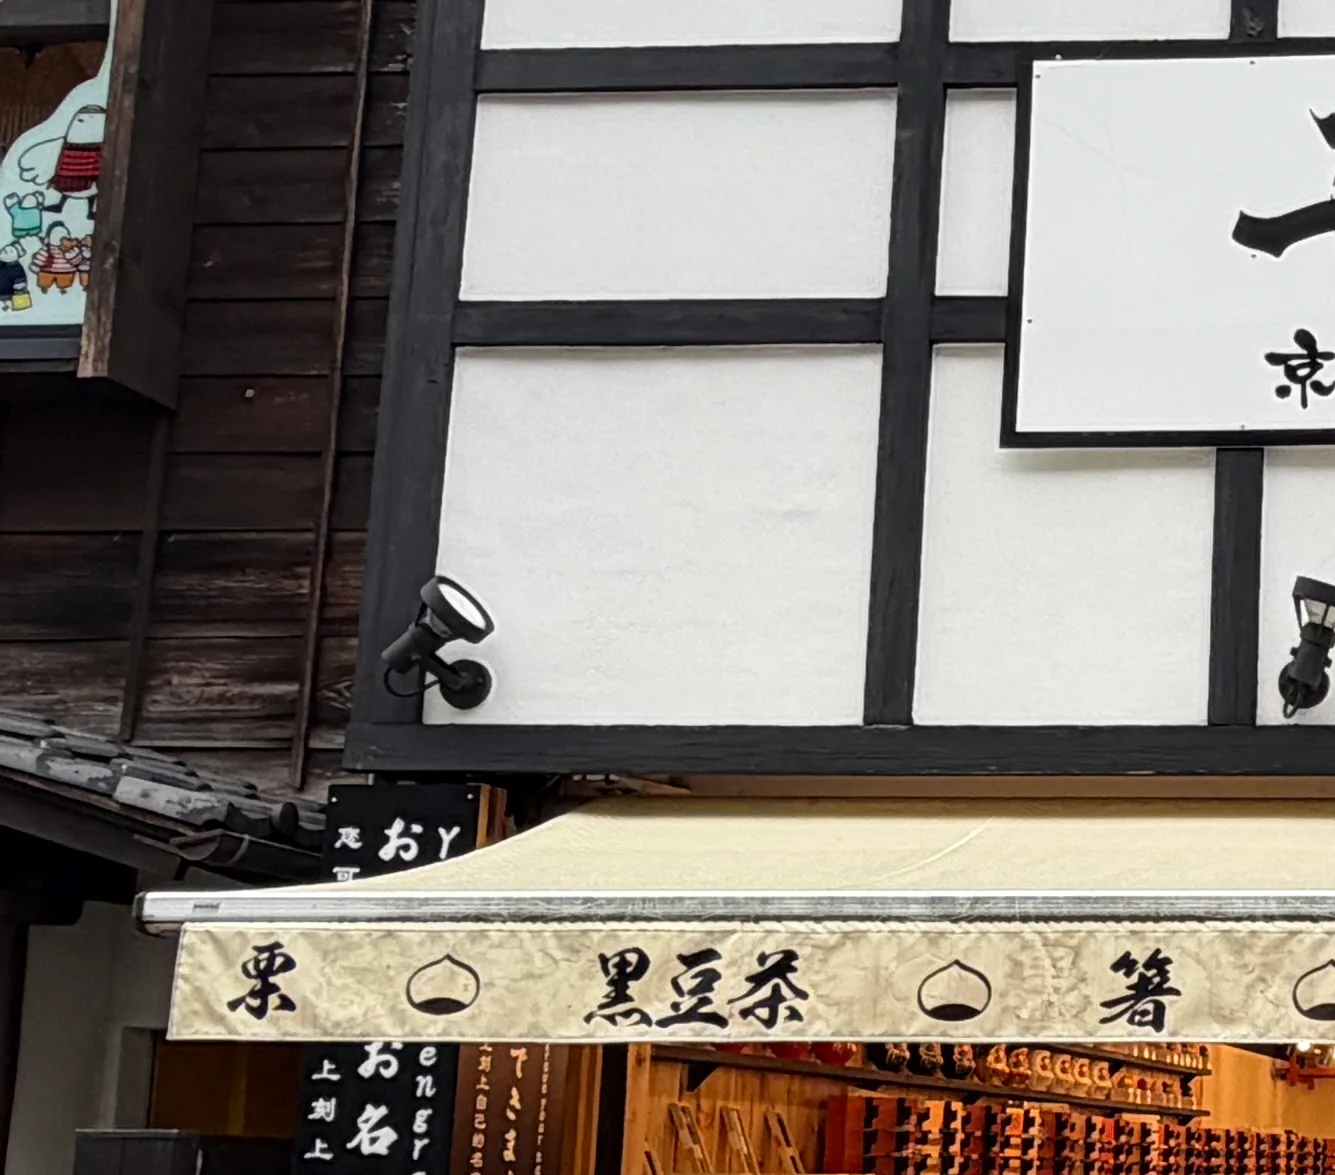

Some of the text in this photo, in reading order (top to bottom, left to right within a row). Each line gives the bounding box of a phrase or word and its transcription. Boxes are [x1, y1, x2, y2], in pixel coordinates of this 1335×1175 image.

[227, 942, 296, 1020] 栗
[584, 947, 809, 1029] 黒豆茶
[1099, 948, 1181, 1032] 箸
